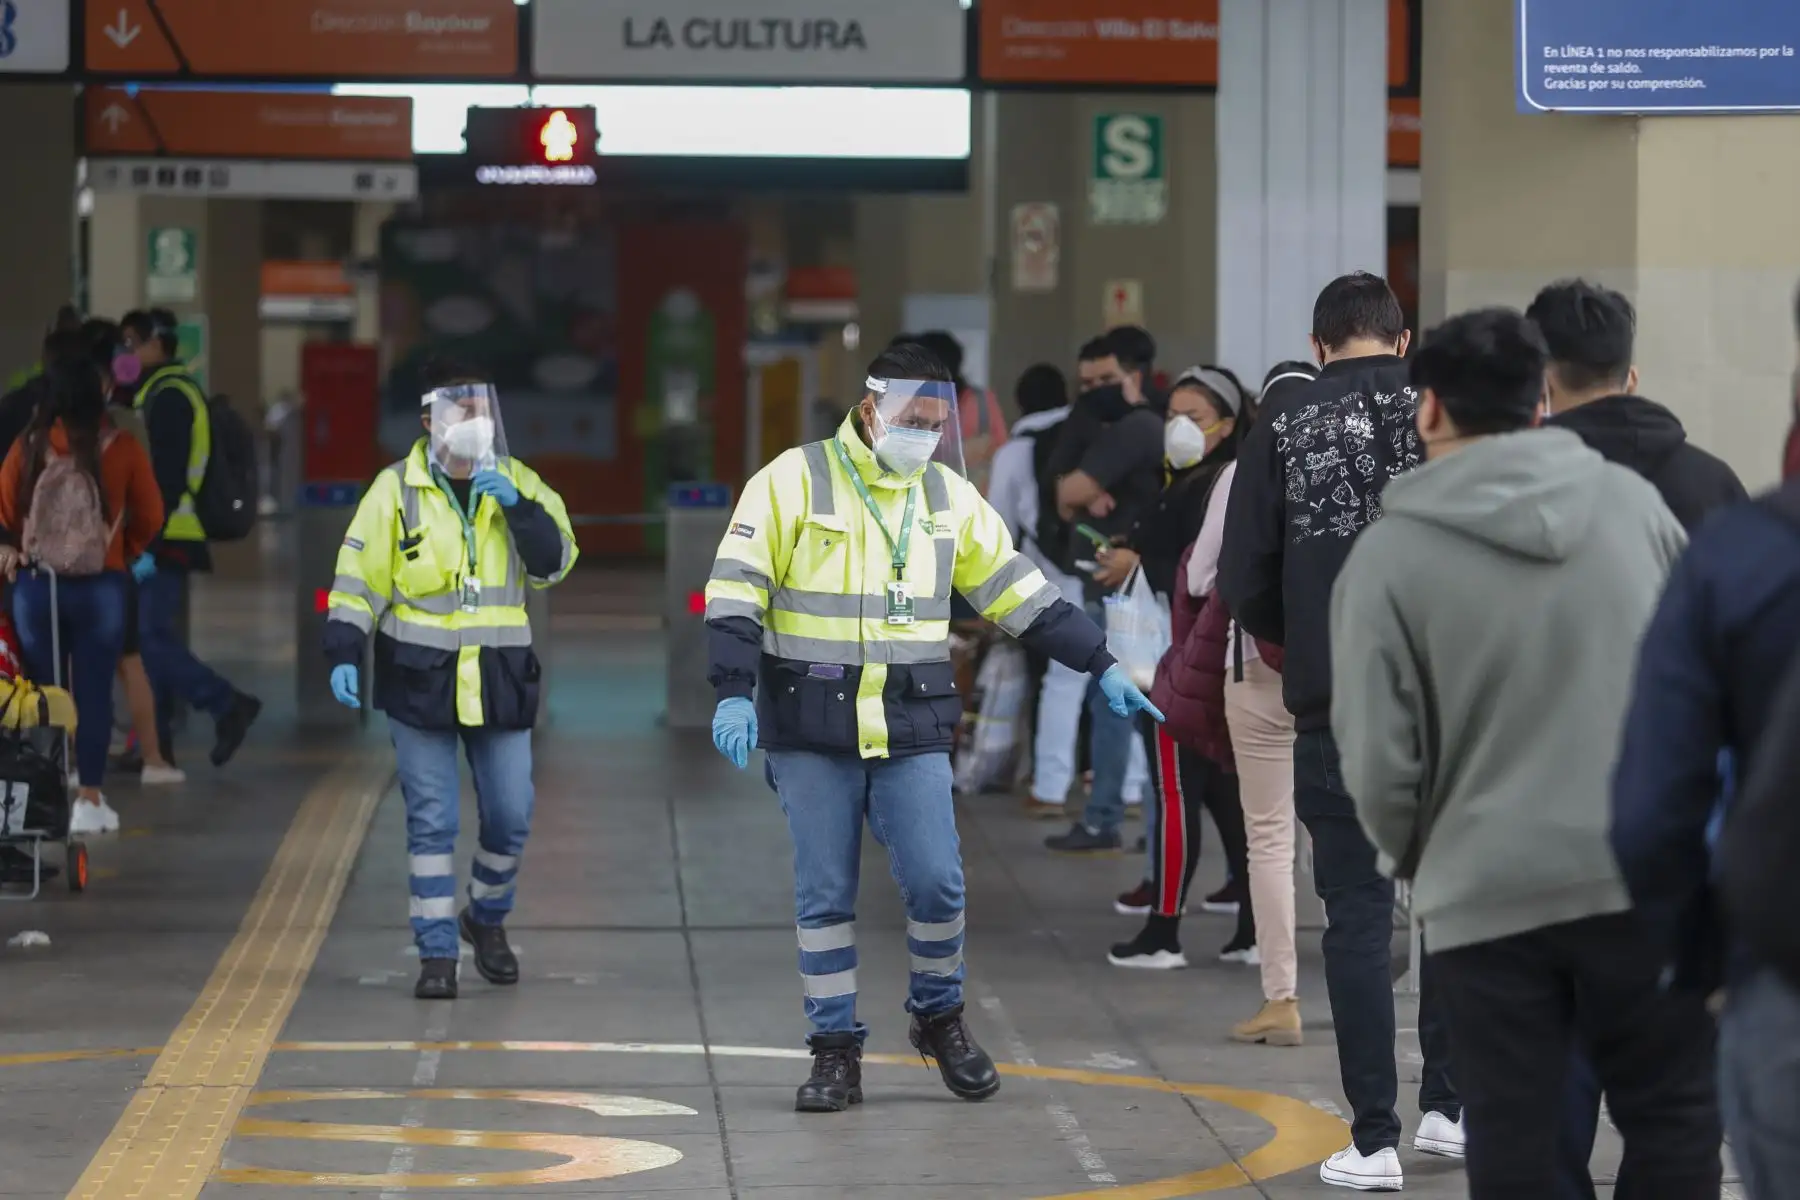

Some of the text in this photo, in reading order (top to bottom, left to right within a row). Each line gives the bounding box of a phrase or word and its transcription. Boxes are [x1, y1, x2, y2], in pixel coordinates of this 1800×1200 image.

[623, 17, 868, 51] LA CULTURA
[1543, 43, 1794, 61] En LÍNEA 1 no nos responsabilizamos por la
[1543, 61, 1643, 74] reventa de saldo.
[1543, 76, 1706, 92] Gracias por su comprensión.
[1102, 114, 1154, 178] S
